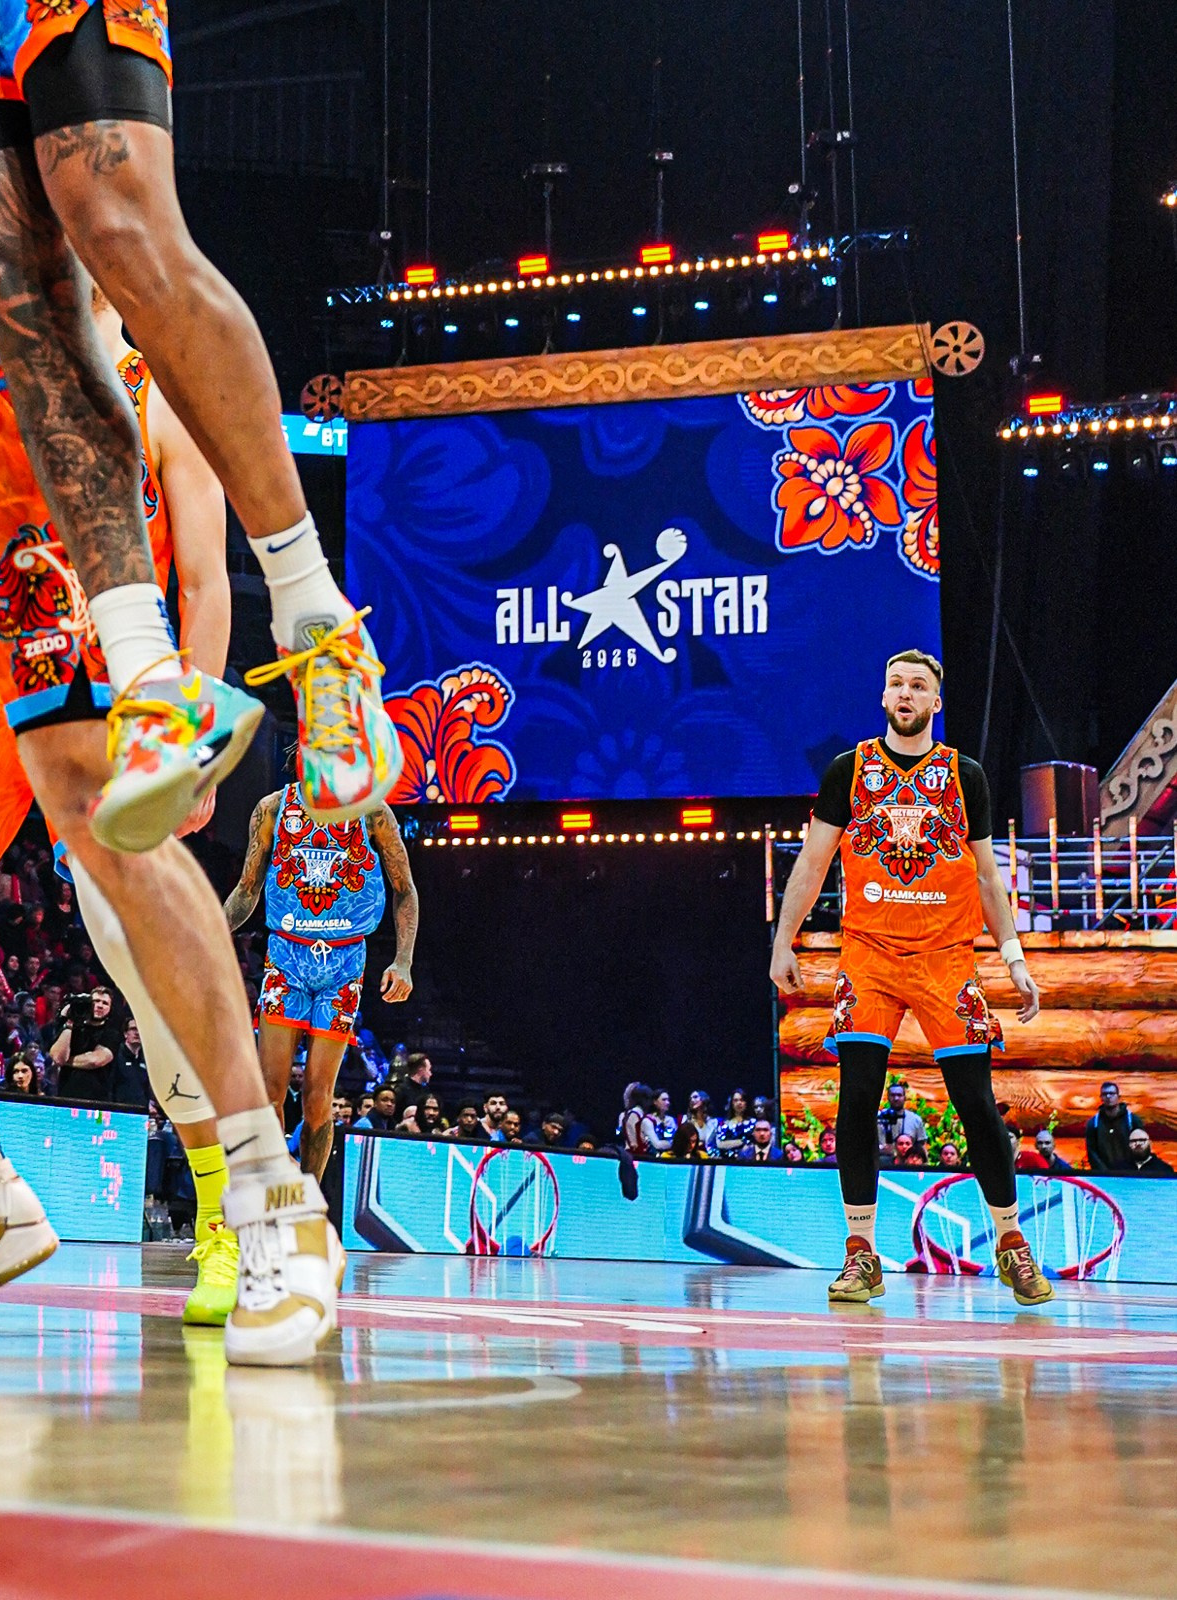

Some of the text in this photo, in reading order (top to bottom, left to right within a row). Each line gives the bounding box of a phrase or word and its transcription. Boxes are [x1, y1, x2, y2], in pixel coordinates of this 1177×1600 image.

[322, 428, 348, 447] ВТ
[496, 575, 768, 644] ALL STAR
[23, 634, 68, 659] ZEDO
[925, 765, 949, 791] 37
[883, 889, 947, 901] КАМКАБЕЛЬ
[296, 919, 352, 928] КАМКАБЕЛЬ
[265, 1182, 306, 1213] NIKE
